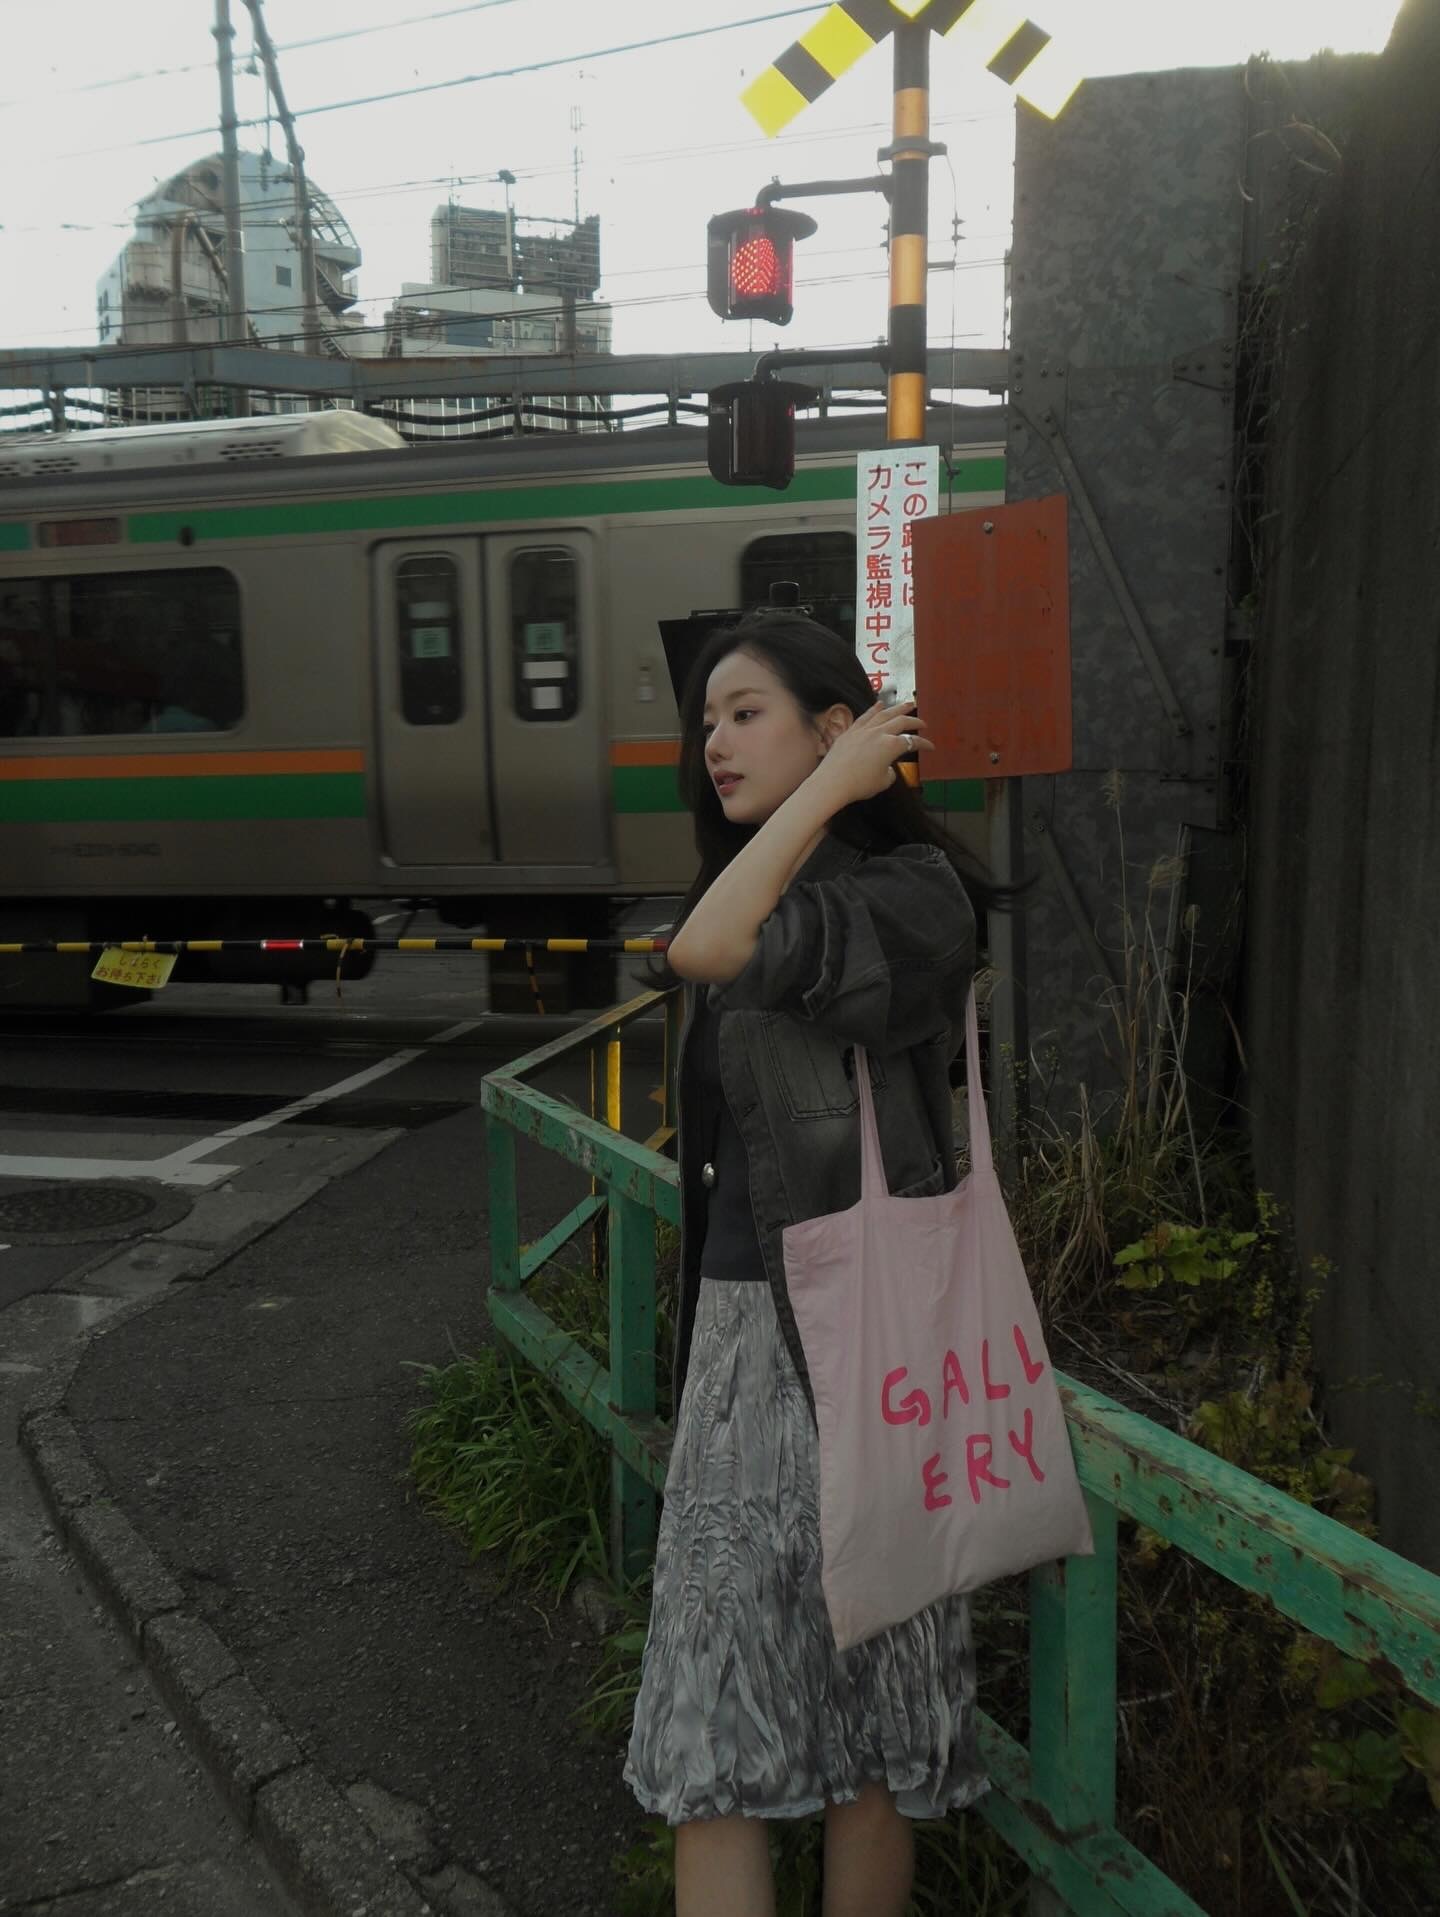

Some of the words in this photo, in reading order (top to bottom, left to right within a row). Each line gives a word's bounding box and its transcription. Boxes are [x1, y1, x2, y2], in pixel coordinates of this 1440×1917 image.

[865, 464, 893, 693] カメラ監視中です
[881, 1323, 1045, 1427] GALL
[922, 1407, 1045, 1512] ERY
